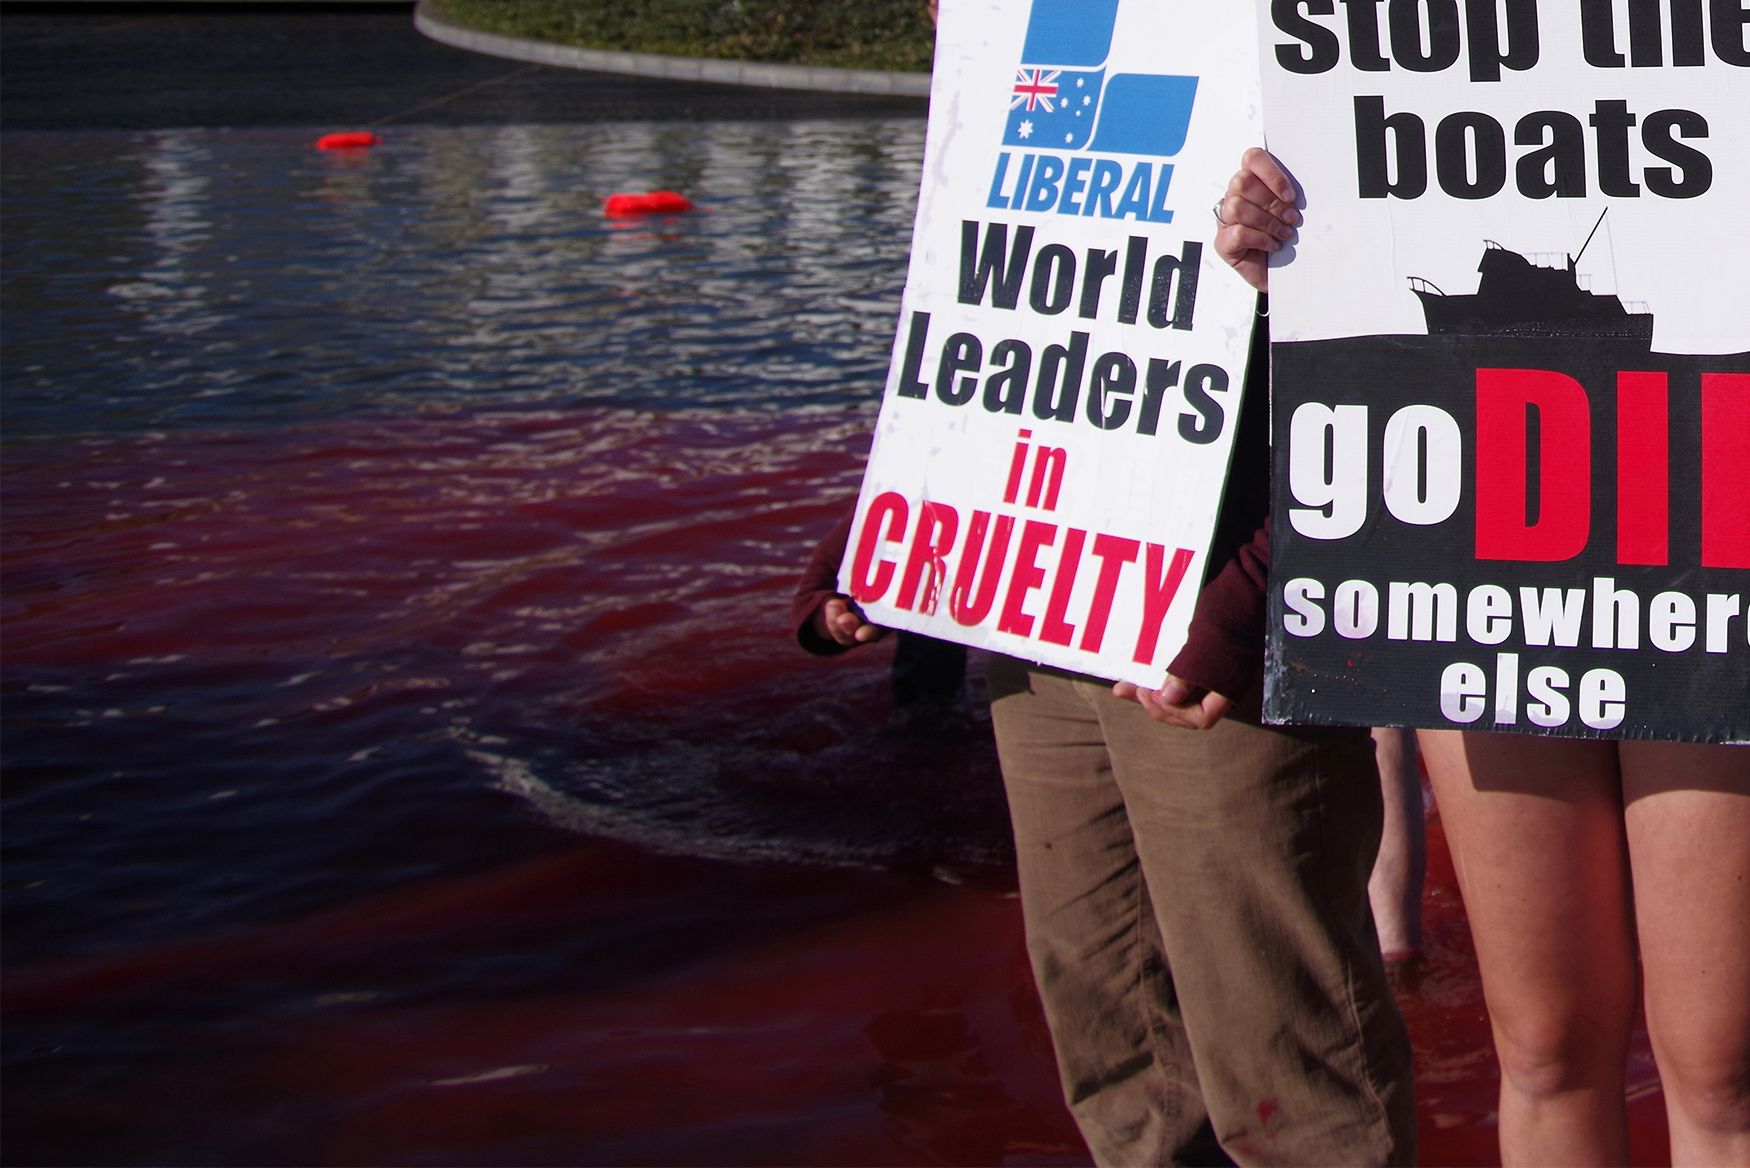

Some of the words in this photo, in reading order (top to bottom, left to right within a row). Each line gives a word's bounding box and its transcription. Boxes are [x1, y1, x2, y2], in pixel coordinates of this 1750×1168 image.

[986, 152, 1176, 224] LIBERAL
[1354, 95, 1714, 200] boats
[957, 220, 1204, 331] World
[896, 311, 1230, 445] Leaders
[1003, 428, 1067, 511] in
[849, 491, 1196, 666] CRUELTY
[1440, 652, 1627, 730] else
